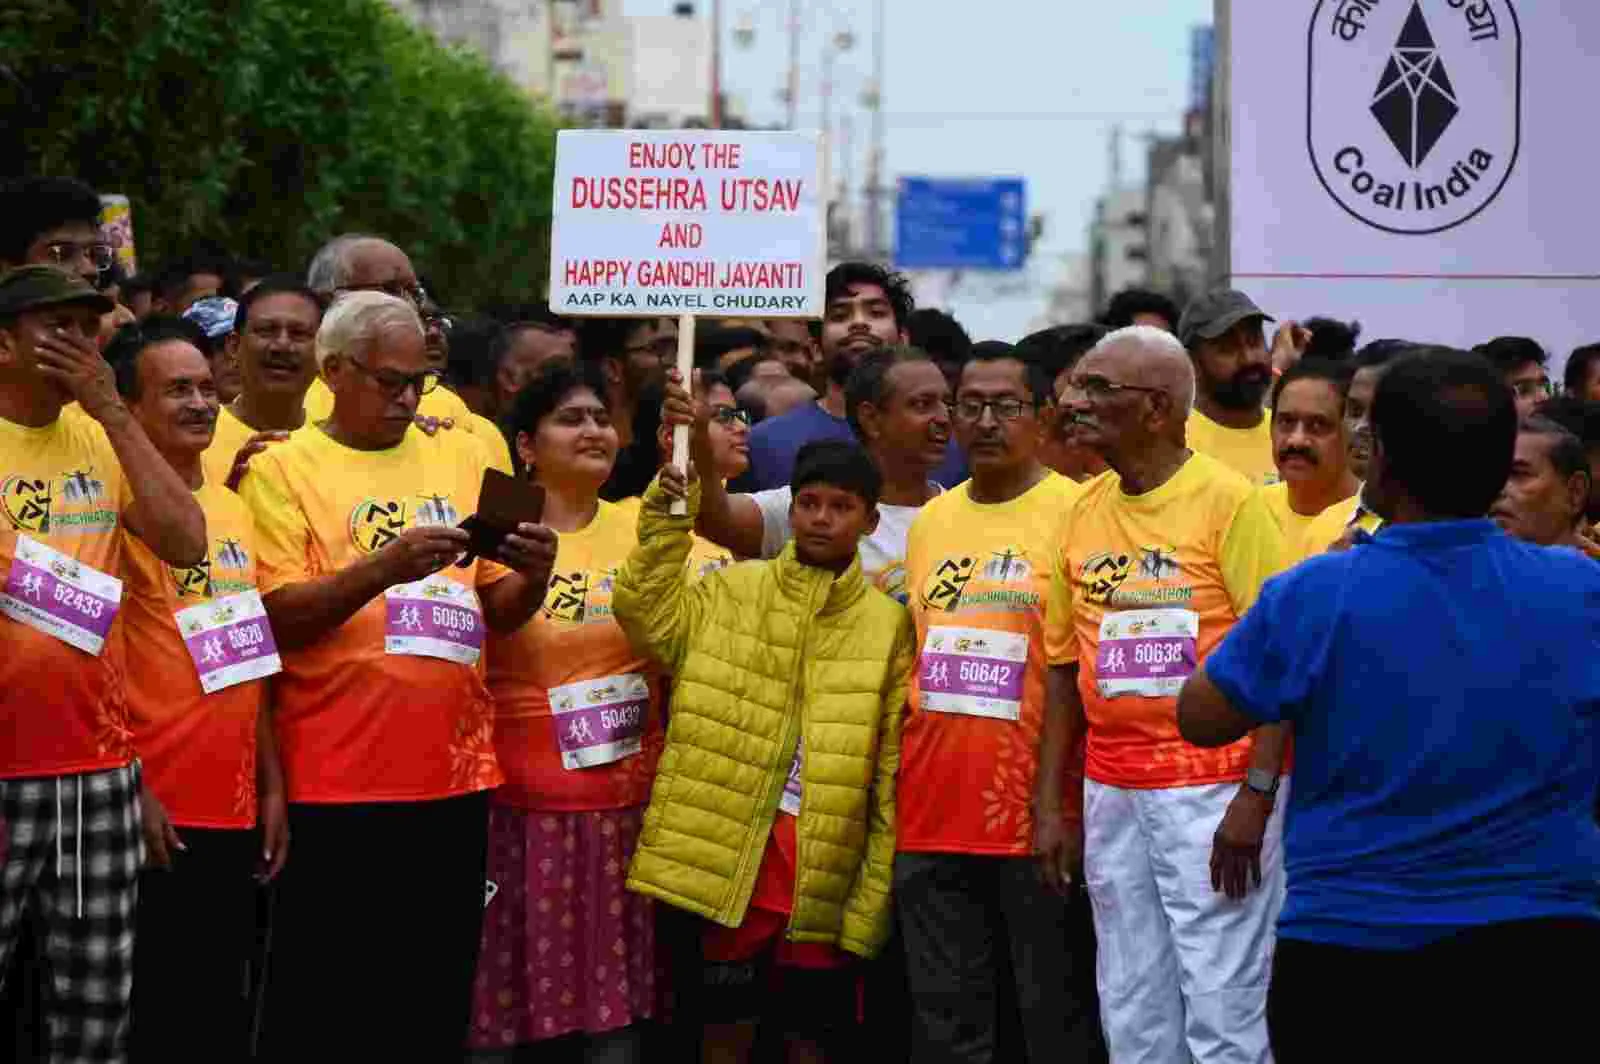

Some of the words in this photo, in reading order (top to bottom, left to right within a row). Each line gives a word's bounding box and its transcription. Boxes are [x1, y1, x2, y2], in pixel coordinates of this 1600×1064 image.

[702, 144, 740, 169] THE
[1334, 147, 1406, 210] Coal
[1414, 148, 1493, 210] India
[572, 178, 707, 209] DUSSEHRA
[720, 179, 801, 210] UTSAV
[660, 224, 702, 248] AND
[565, 261, 631, 287] HAPPY
[637, 261, 714, 288] GANDHI
[720, 263, 802, 289] JAYANTI
[567, 293, 605, 306] AAP
[610, 293, 637, 307] KA
[647, 294, 707, 308] NAYEL
[713, 295, 806, 309] CHUDARY
[959, 661, 1011, 686] 50642
